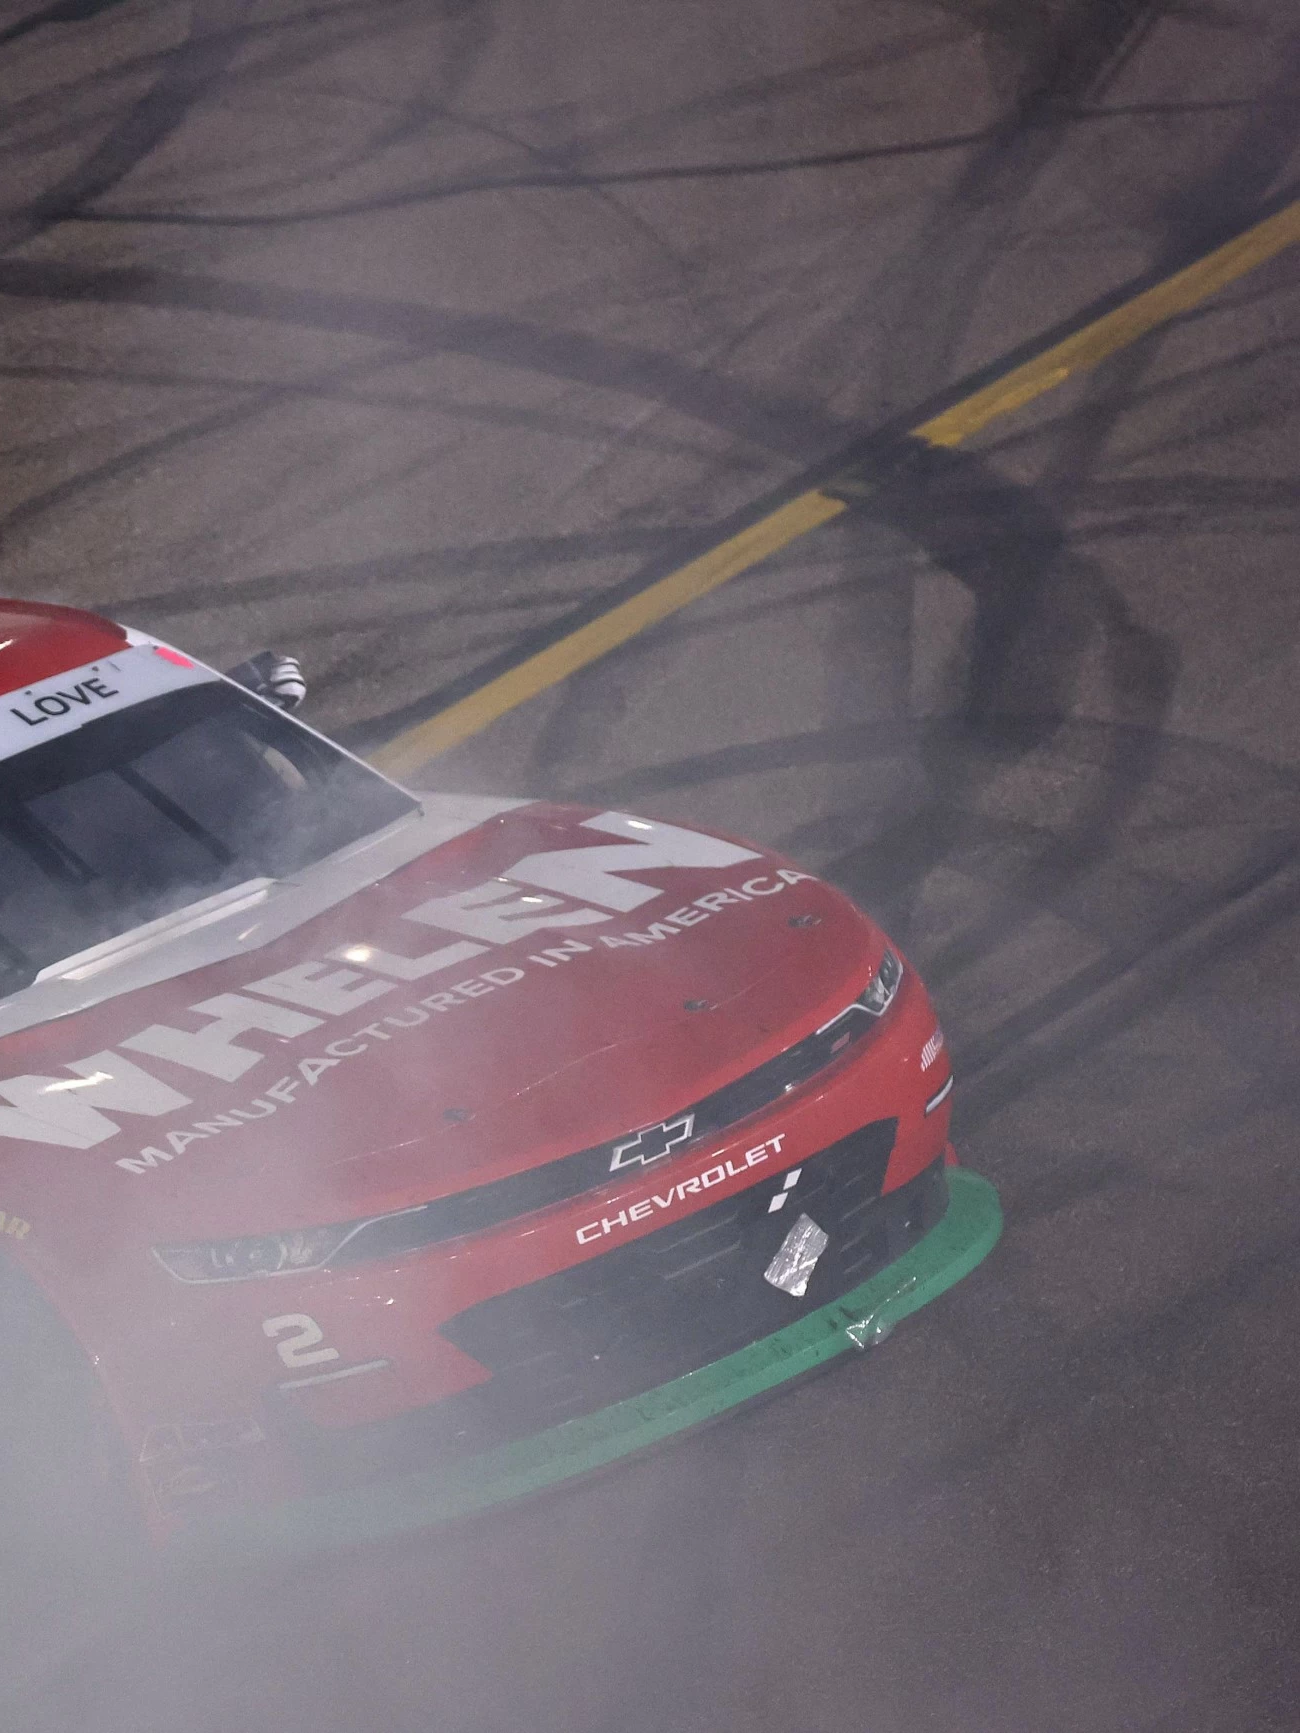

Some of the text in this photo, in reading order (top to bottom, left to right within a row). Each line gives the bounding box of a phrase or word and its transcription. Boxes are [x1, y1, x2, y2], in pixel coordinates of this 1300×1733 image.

[10, 678, 119, 726] LOVE
[116, 867, 814, 1175] MANUFACTURED IN AMERICA
[575, 1133, 786, 1245] CHEVROLET
[261, 1313, 339, 1368] 2
